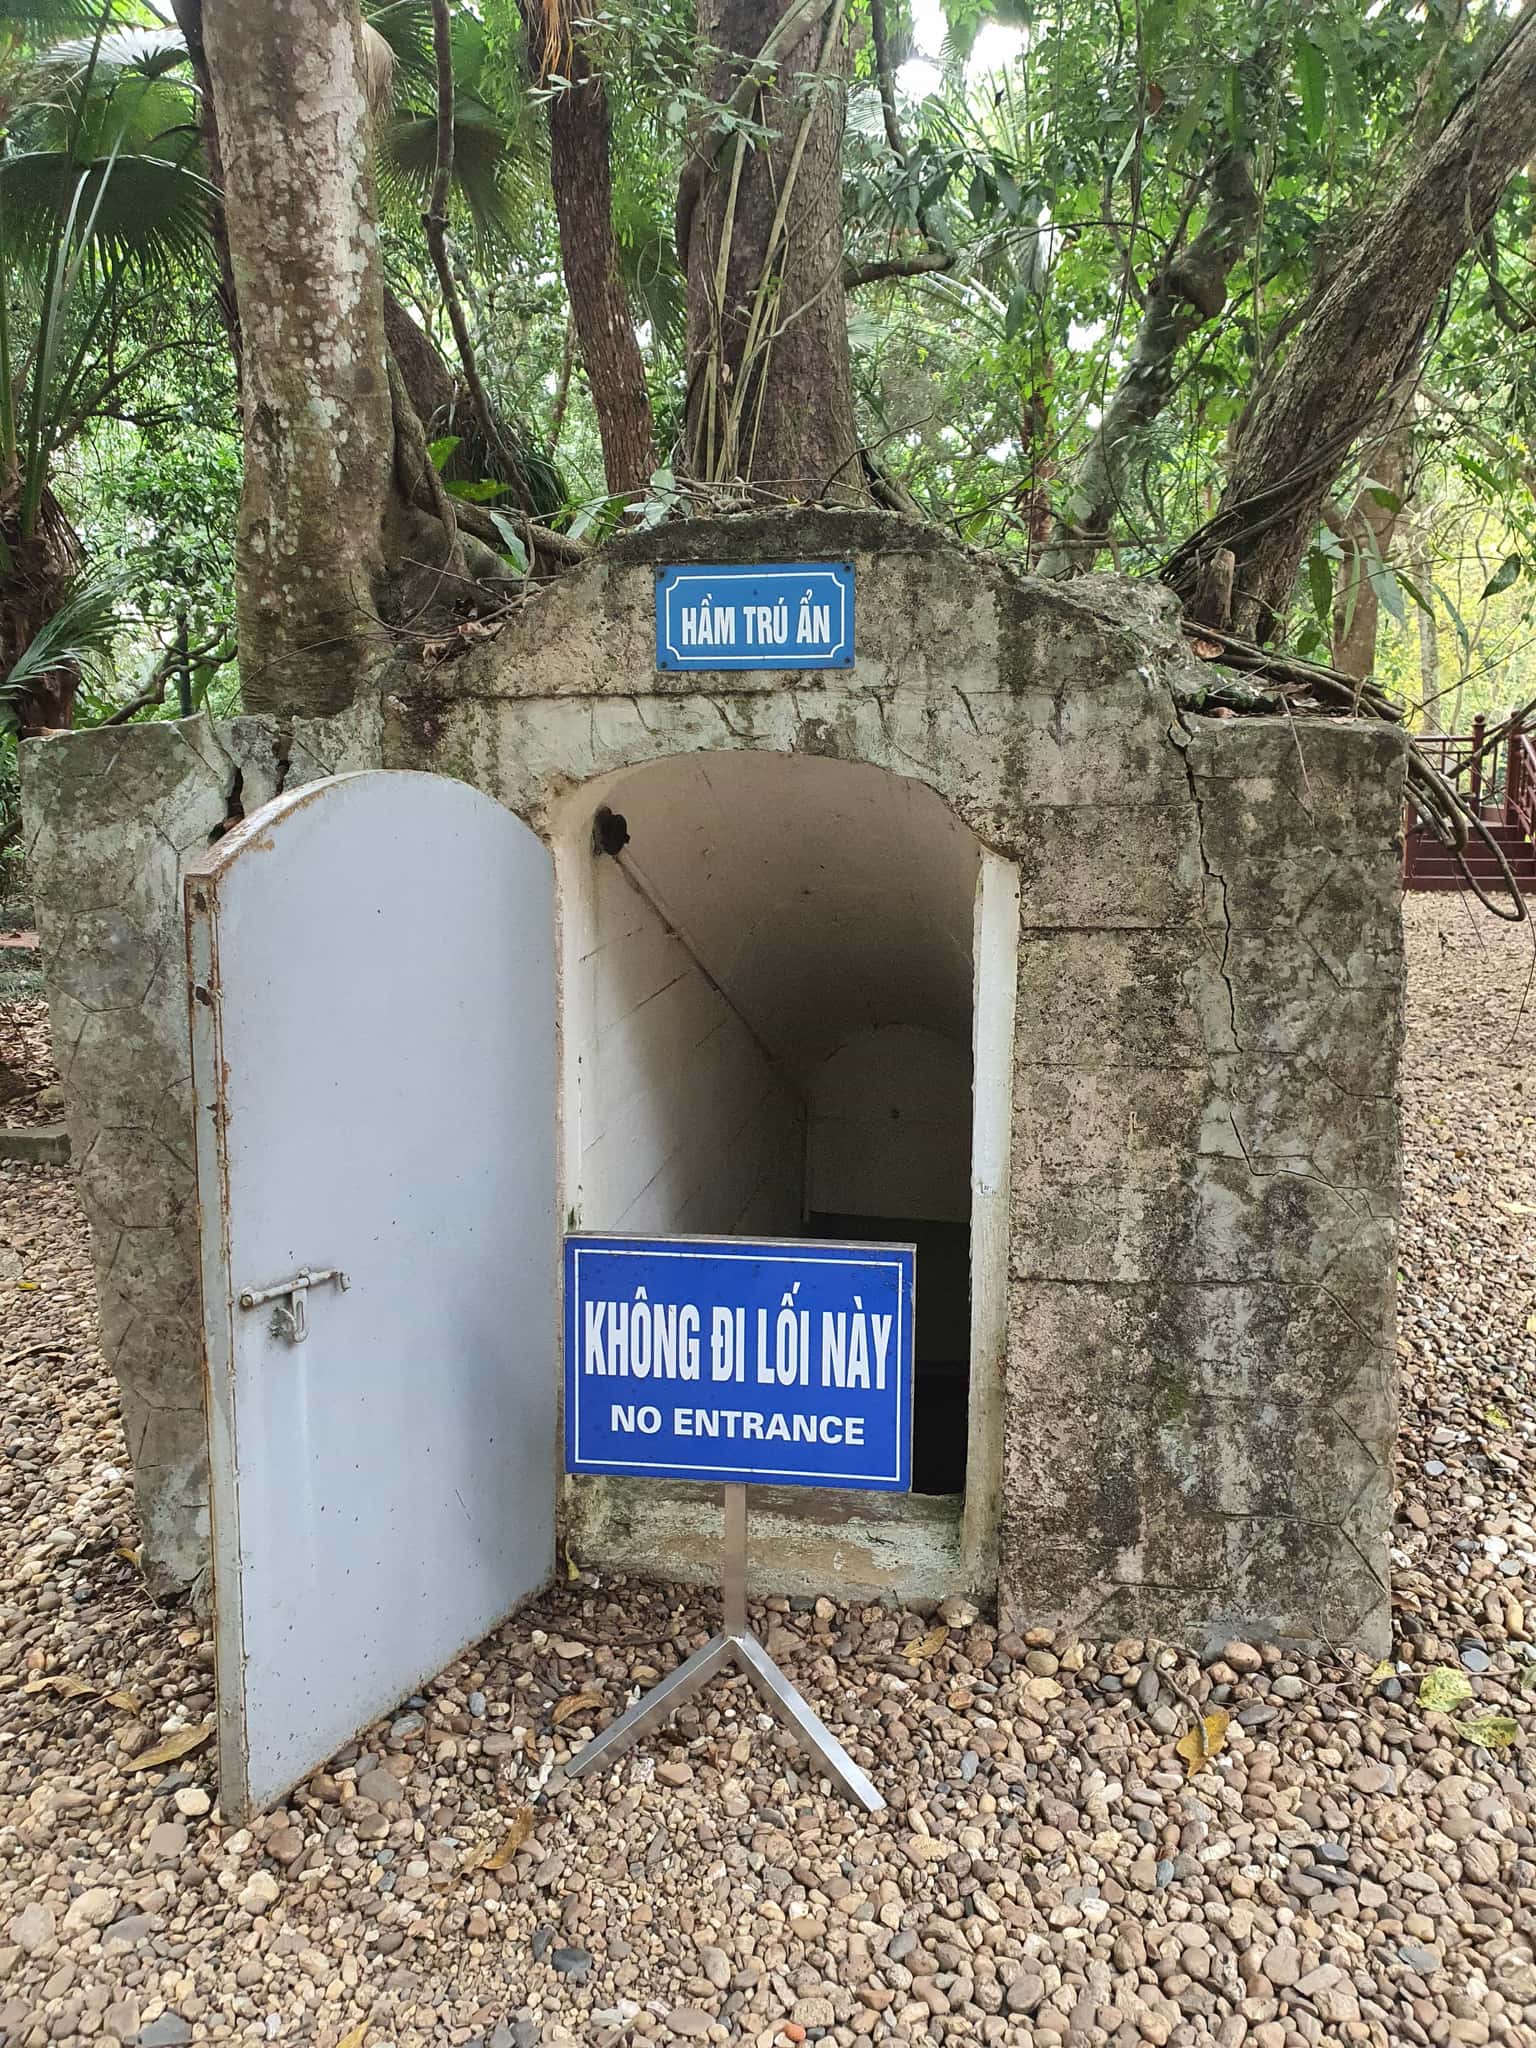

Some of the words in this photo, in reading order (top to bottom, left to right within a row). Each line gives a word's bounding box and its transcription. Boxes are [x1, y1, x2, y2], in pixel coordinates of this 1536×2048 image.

[681, 593, 736, 645] HẦM
[743, 597, 789, 645] TRÚ
[796, 588, 831, 644] ẨN
[584, 1286, 700, 1381] KHÔNG
[711, 1306, 746, 1383] ĐI
[757, 1281, 810, 1387] LỐI
[822, 1295, 893, 1390] NÀY
[611, 1404, 662, 1434] NO
[673, 1407, 866, 1446] ENTRANCE
